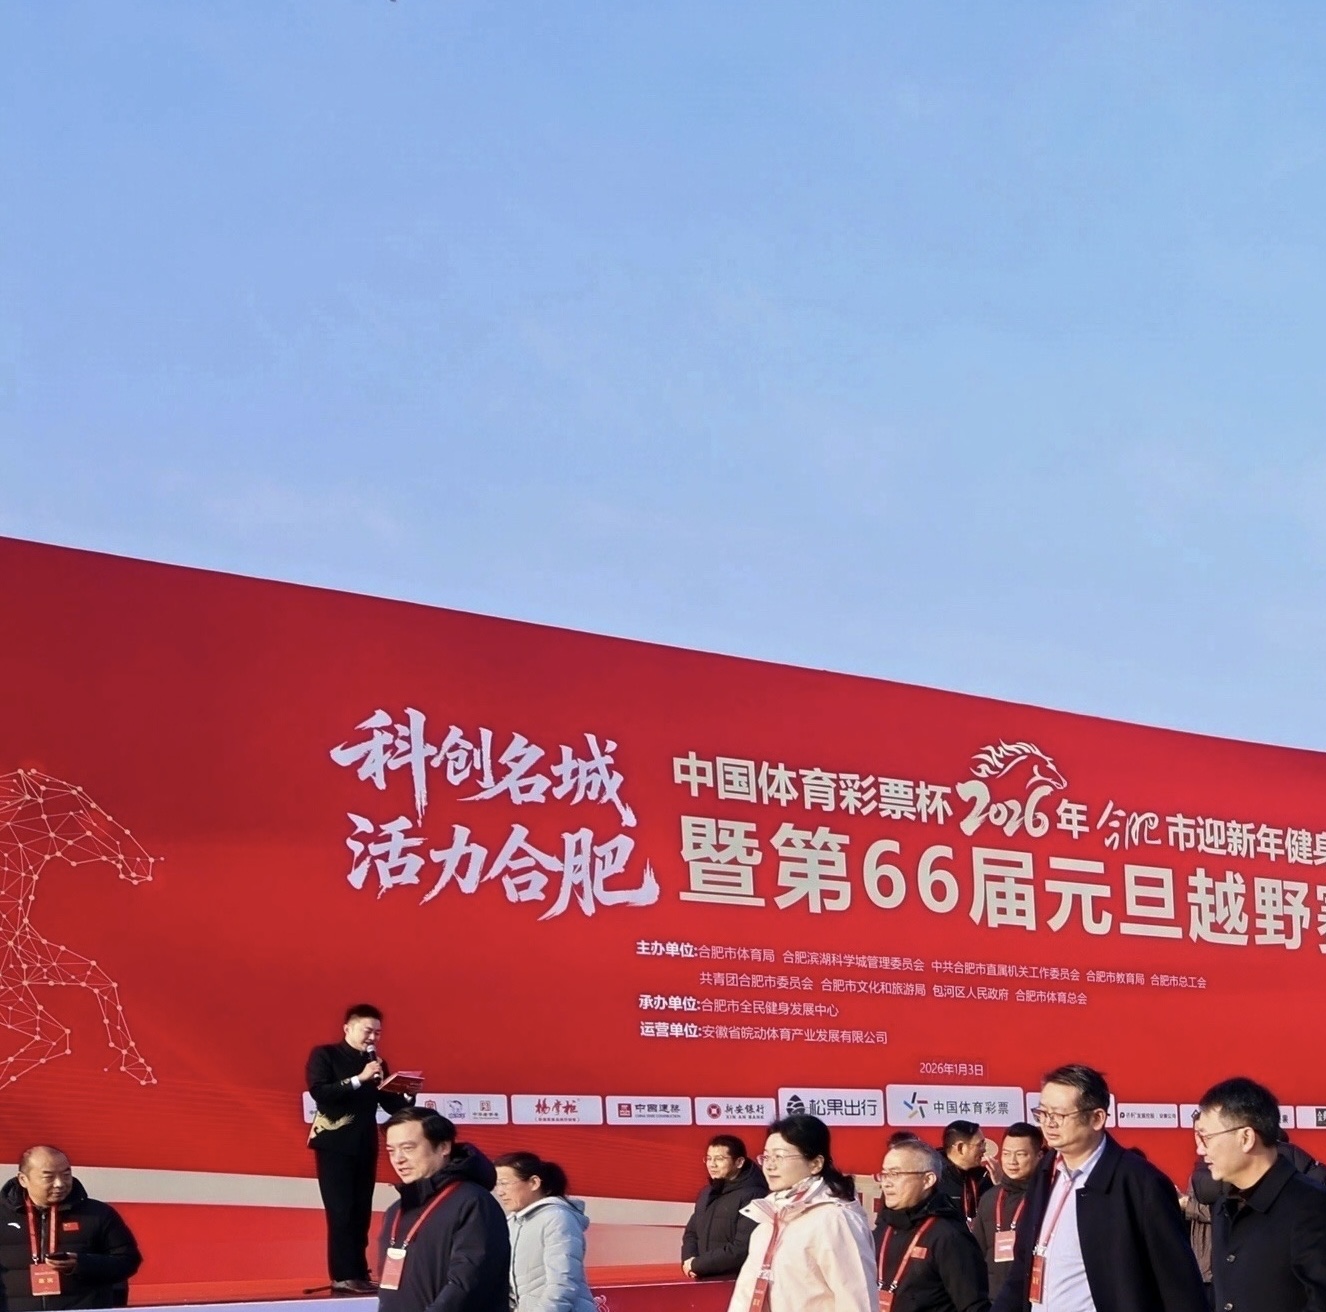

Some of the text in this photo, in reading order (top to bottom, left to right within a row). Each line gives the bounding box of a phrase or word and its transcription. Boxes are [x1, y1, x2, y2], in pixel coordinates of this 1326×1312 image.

[330, 707, 637, 827] 科创名城
[346, 812, 660, 921] 活力合肥
[782, 950, 925, 972] 合肥滨湖科学城管理委员会
[931, 960, 1080, 982] 中共合肥市直属机关工作委员会
[1086, 971, 1145, 986] 合肥市教育局
[1150, 974, 1207, 989] 合肥市总工会
[700, 972, 1087, 1005] 共青团合肥市委员会 合肥市文化和旅游局 包河区人民政府 合肥市体育总会
[920, 1062, 984, 1077] 2026年1月3日
[724, 1103, 764, 1115] 新安银行
[809, 1098, 878, 1117] 松果出行
[933, 1100, 1009, 1115] 中国体育彩票
